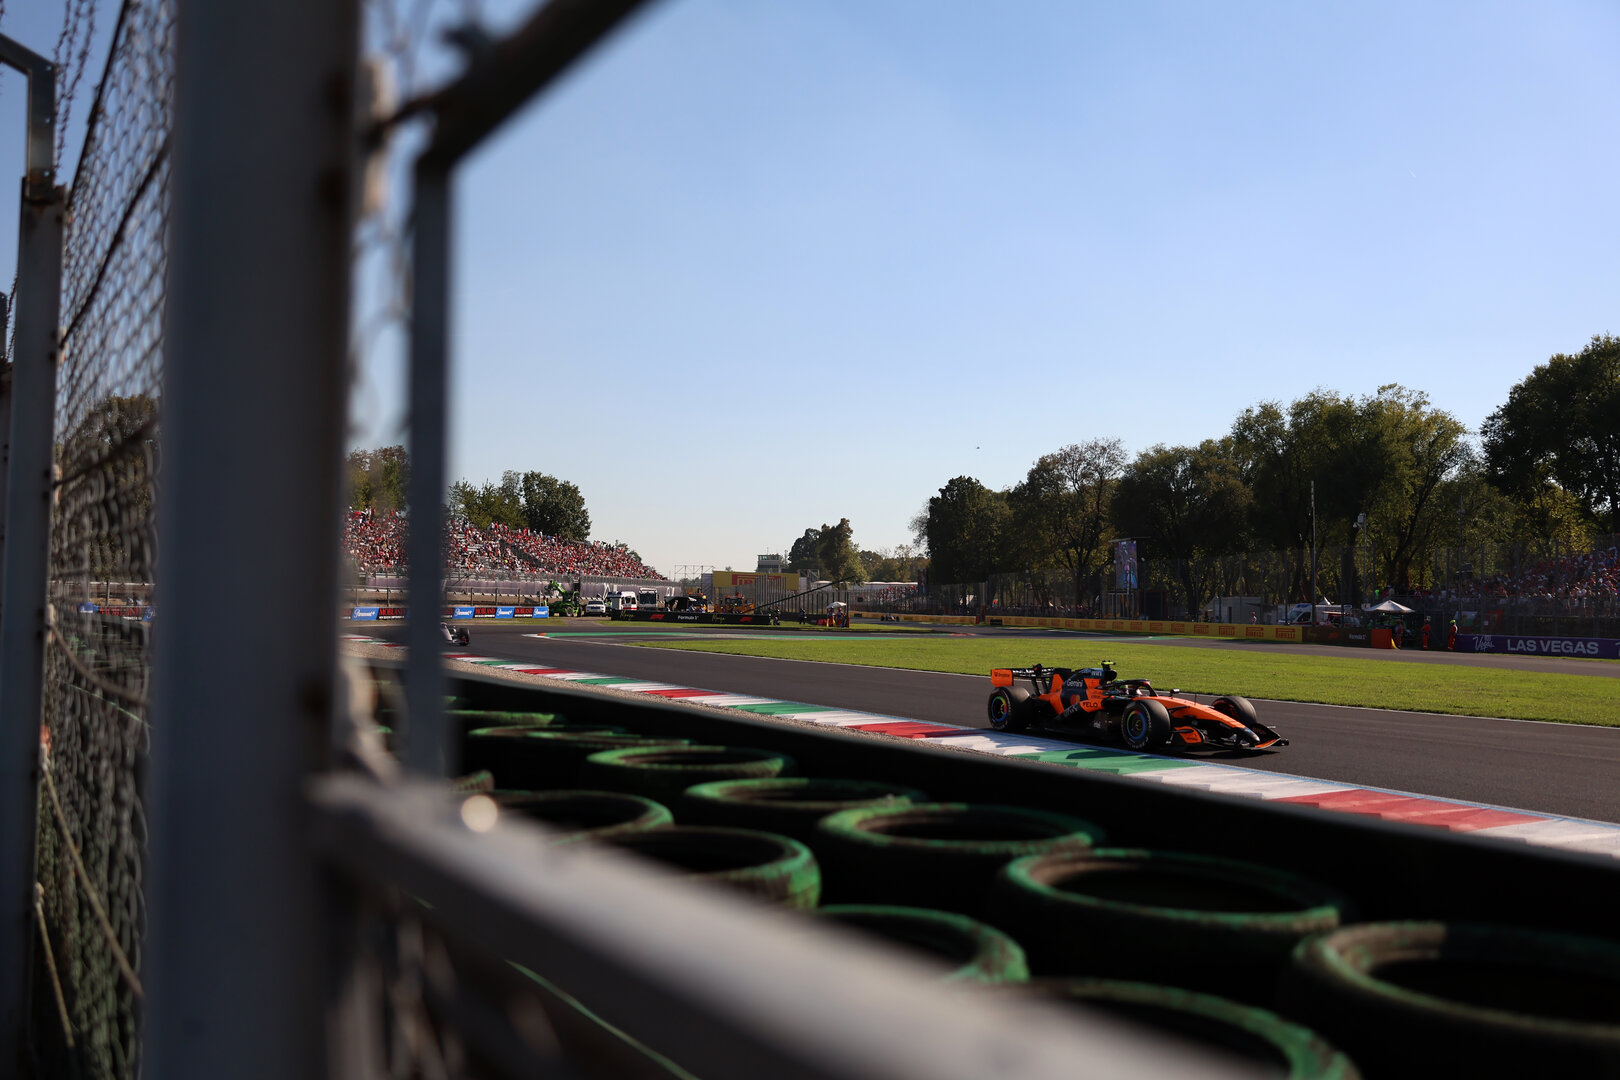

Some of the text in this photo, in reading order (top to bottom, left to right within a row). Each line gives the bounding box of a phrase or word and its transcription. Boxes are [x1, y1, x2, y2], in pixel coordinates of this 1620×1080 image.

[1507, 639, 1599, 654] LAS VEGAS
[1066, 679, 1083, 687] Gemini
